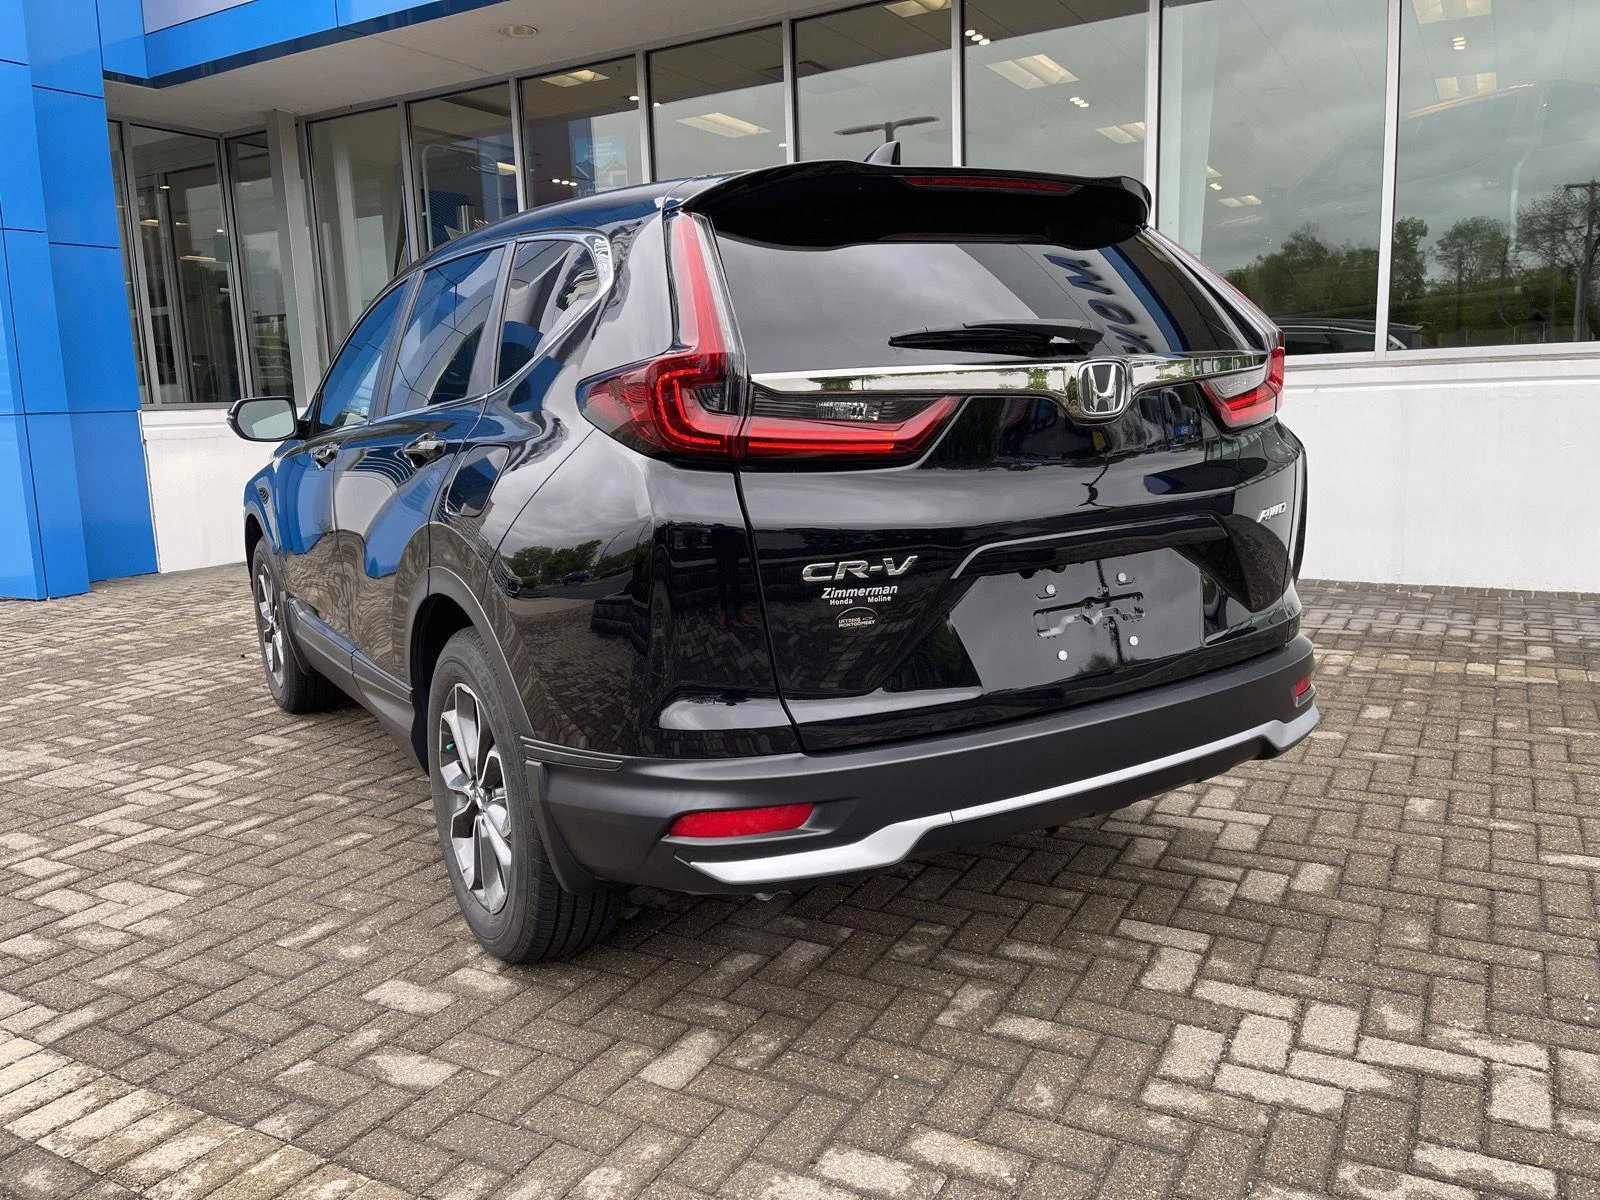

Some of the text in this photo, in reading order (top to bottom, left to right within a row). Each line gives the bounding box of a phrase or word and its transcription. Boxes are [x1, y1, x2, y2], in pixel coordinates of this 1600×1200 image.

[1256, 502, 1287, 523] AWD
[802, 555, 918, 582] CR-V
[821, 585, 898, 599] Zimmerman
[829, 595, 892, 606] Honda Moline
